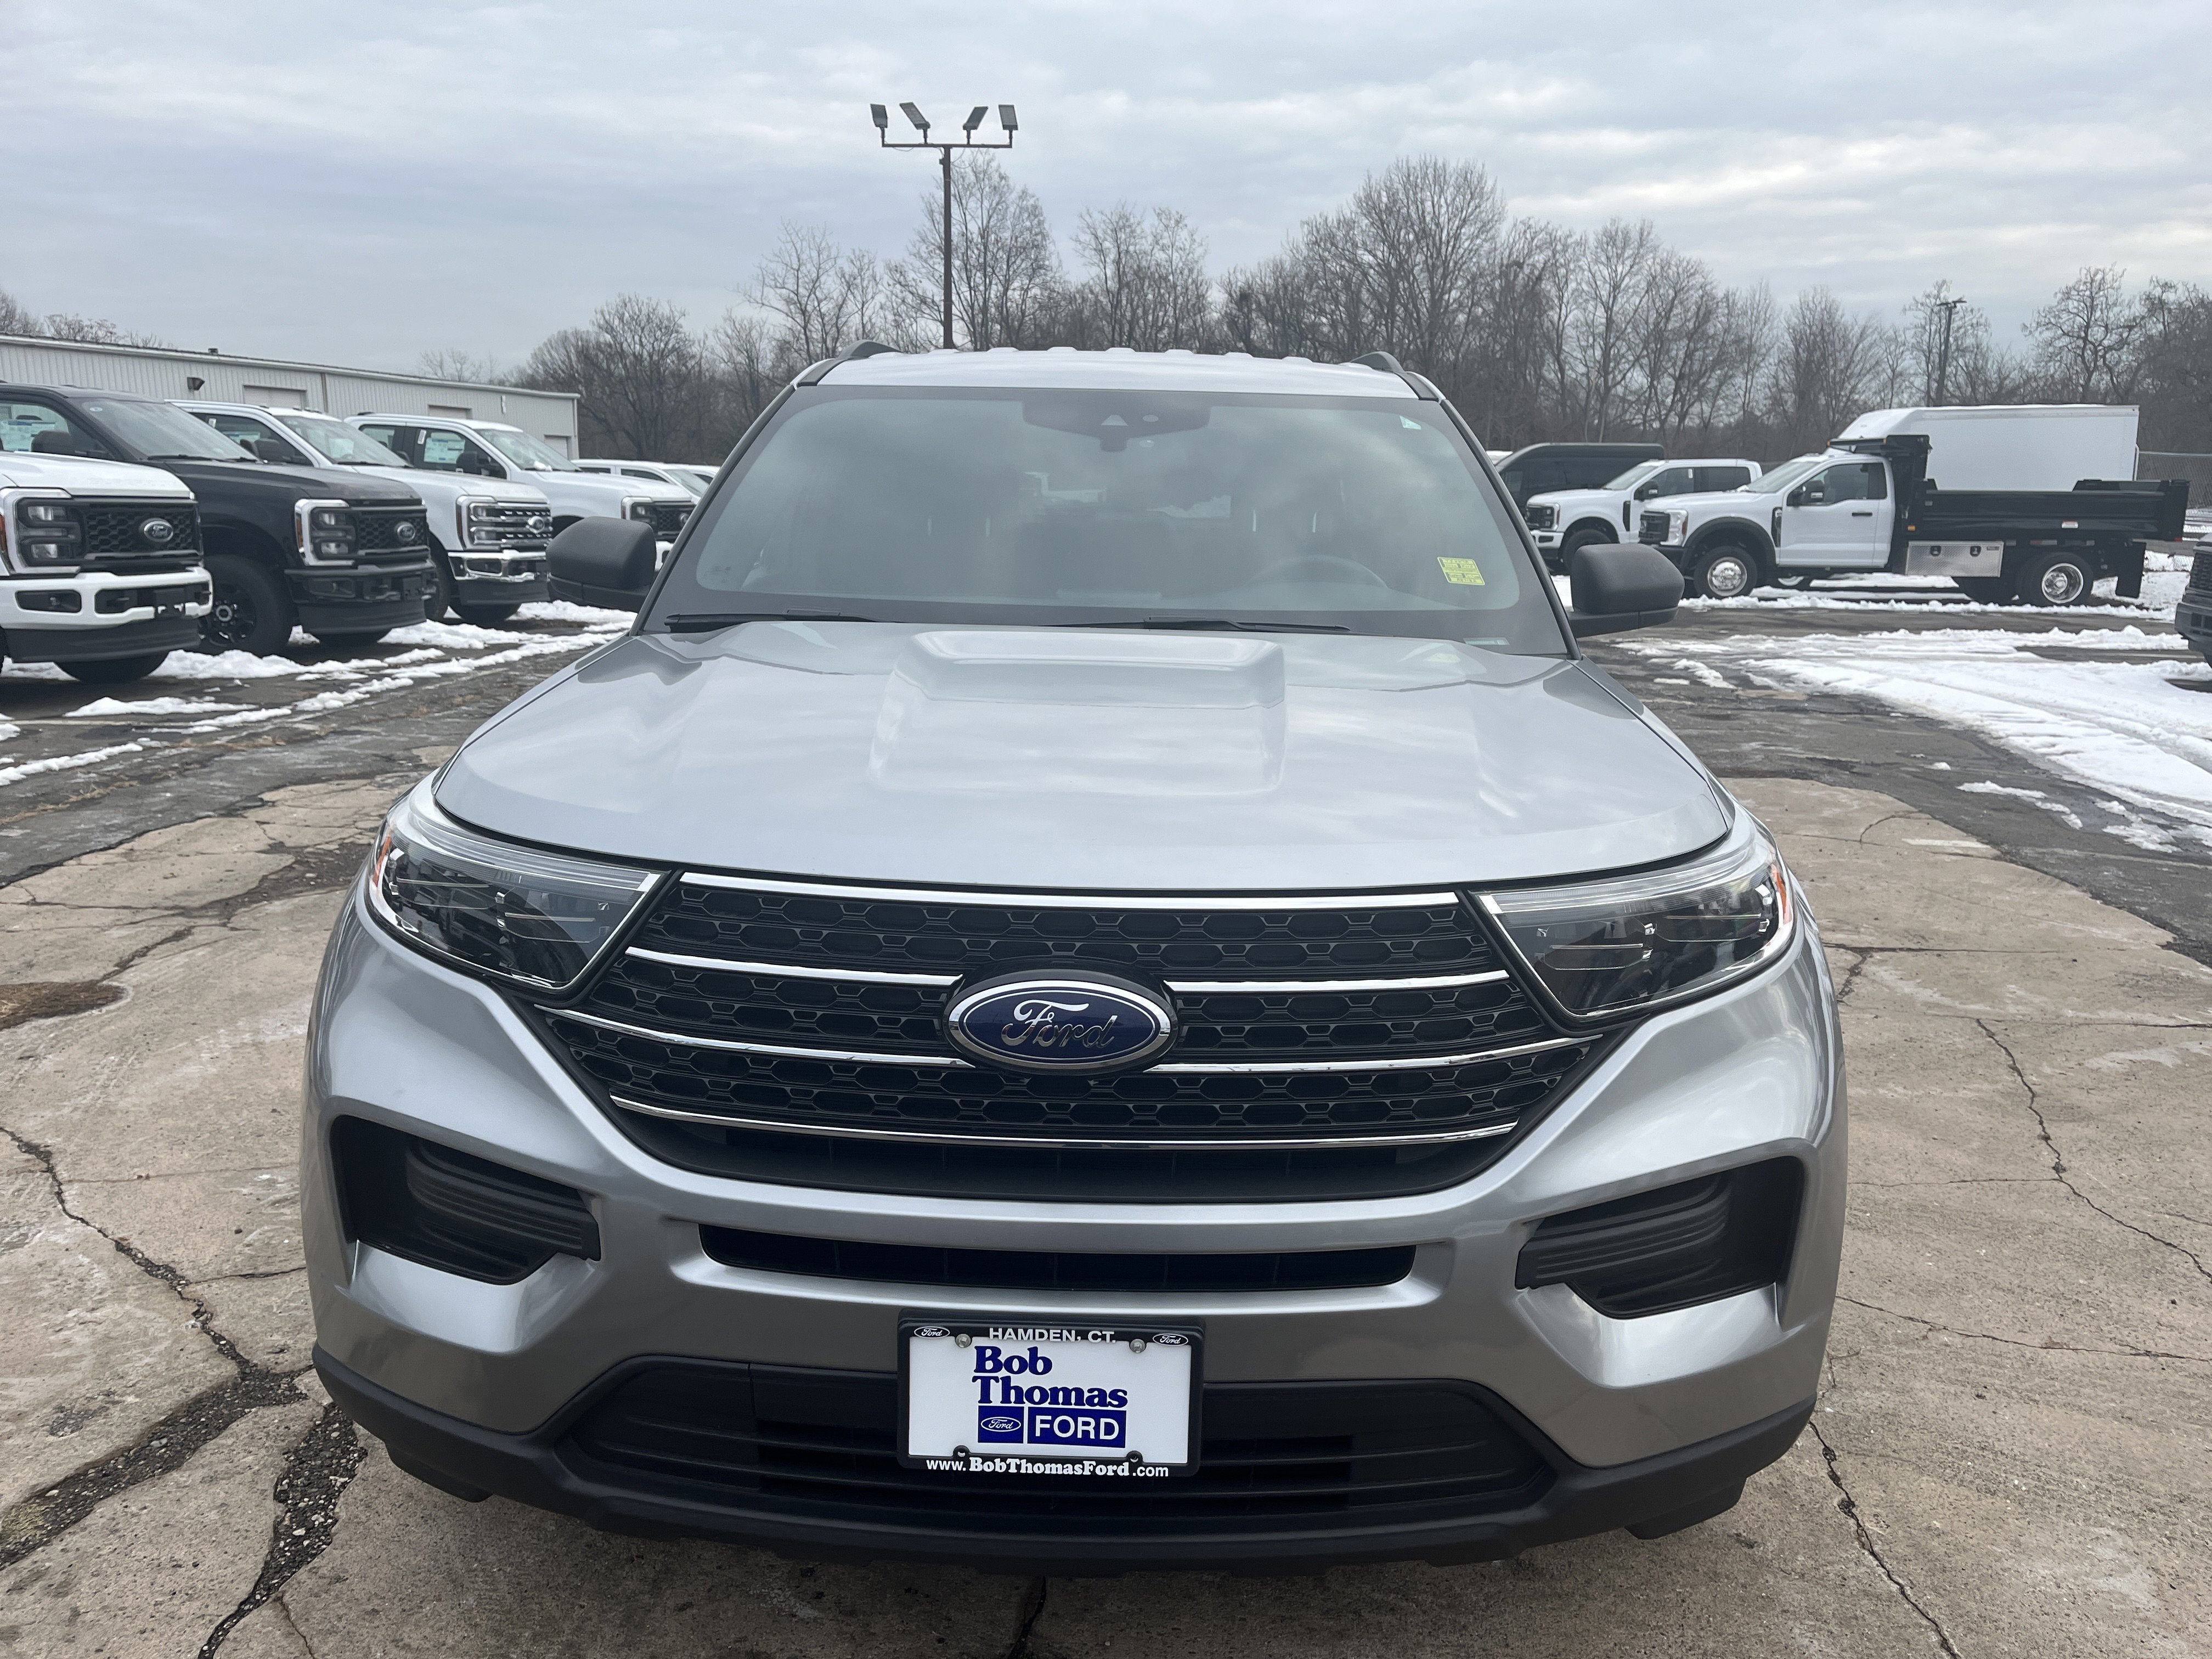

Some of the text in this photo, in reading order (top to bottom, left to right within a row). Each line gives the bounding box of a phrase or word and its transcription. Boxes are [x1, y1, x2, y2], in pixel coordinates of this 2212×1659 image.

[1001, 1000, 1118, 1047] Ford
[922, 1328, 943, 1336] Ford
[989, 1328, 1116, 1344] HAMDEN, CT.
[1160, 1335, 1181, 1344] Ford
[973, 1346, 1053, 1375] Bob
[972, 1375, 1128, 1408] Thomas
[989, 1419, 1013, 1429] Ford
[1035, 1415, 1119, 1440] FORD
[926, 1457, 1169, 1477] www.BobThomasFord.com
